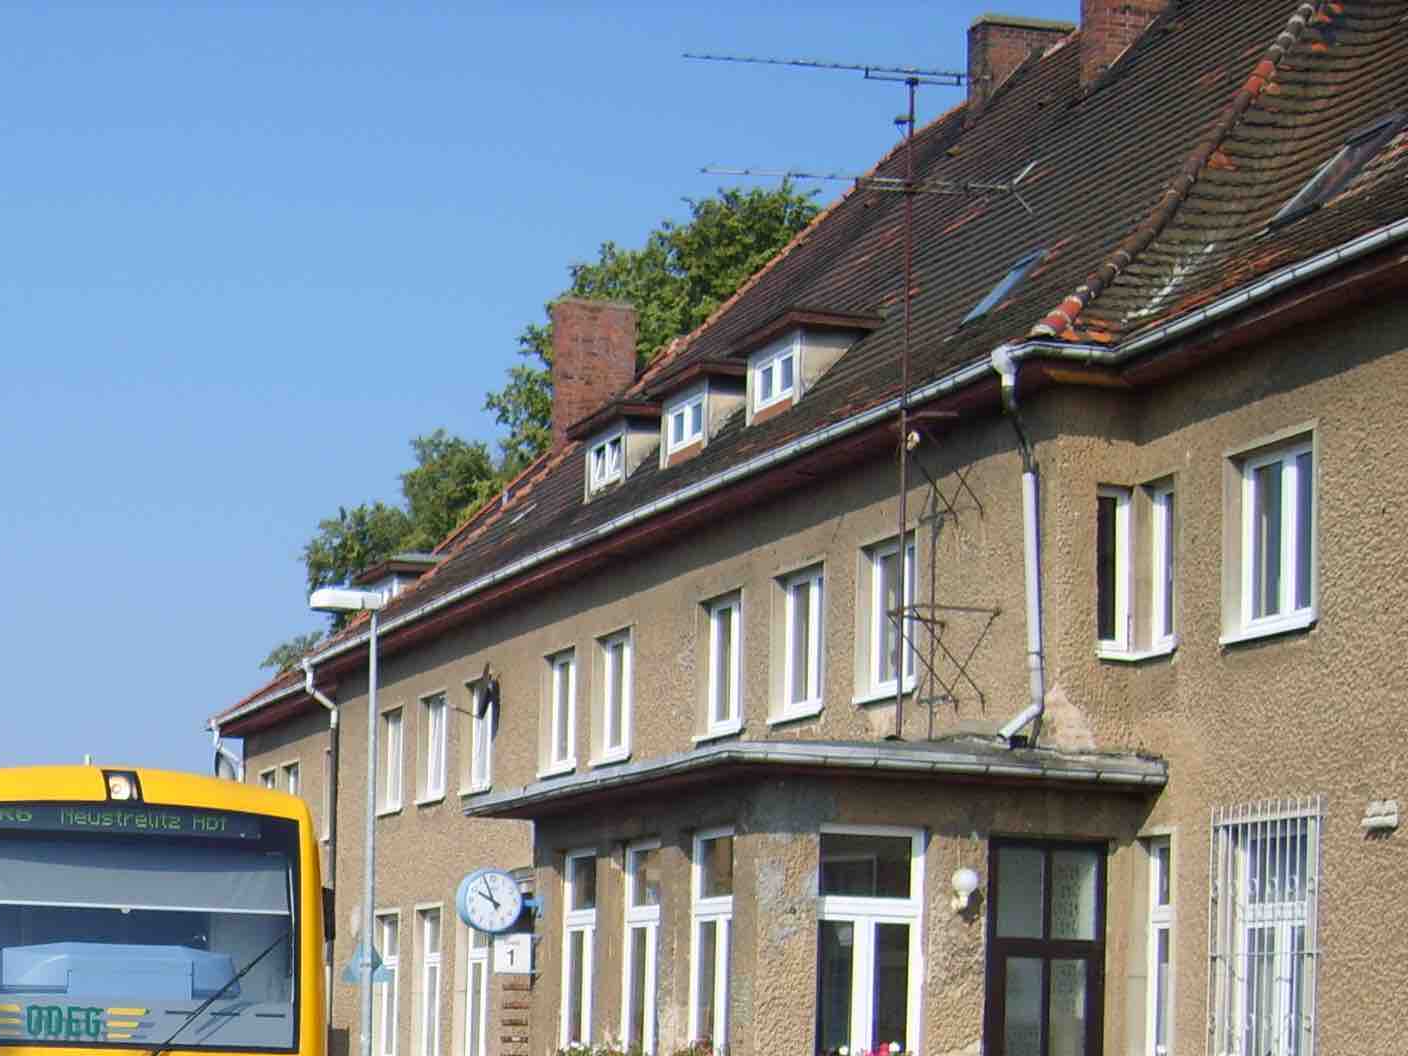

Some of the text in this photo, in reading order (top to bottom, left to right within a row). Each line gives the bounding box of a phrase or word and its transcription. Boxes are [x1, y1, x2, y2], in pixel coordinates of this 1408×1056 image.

[60, 807, 182, 829] Neustrelitz
[506, 949, 515, 966] 1
[26, 1005, 103, 1037] ODEG
